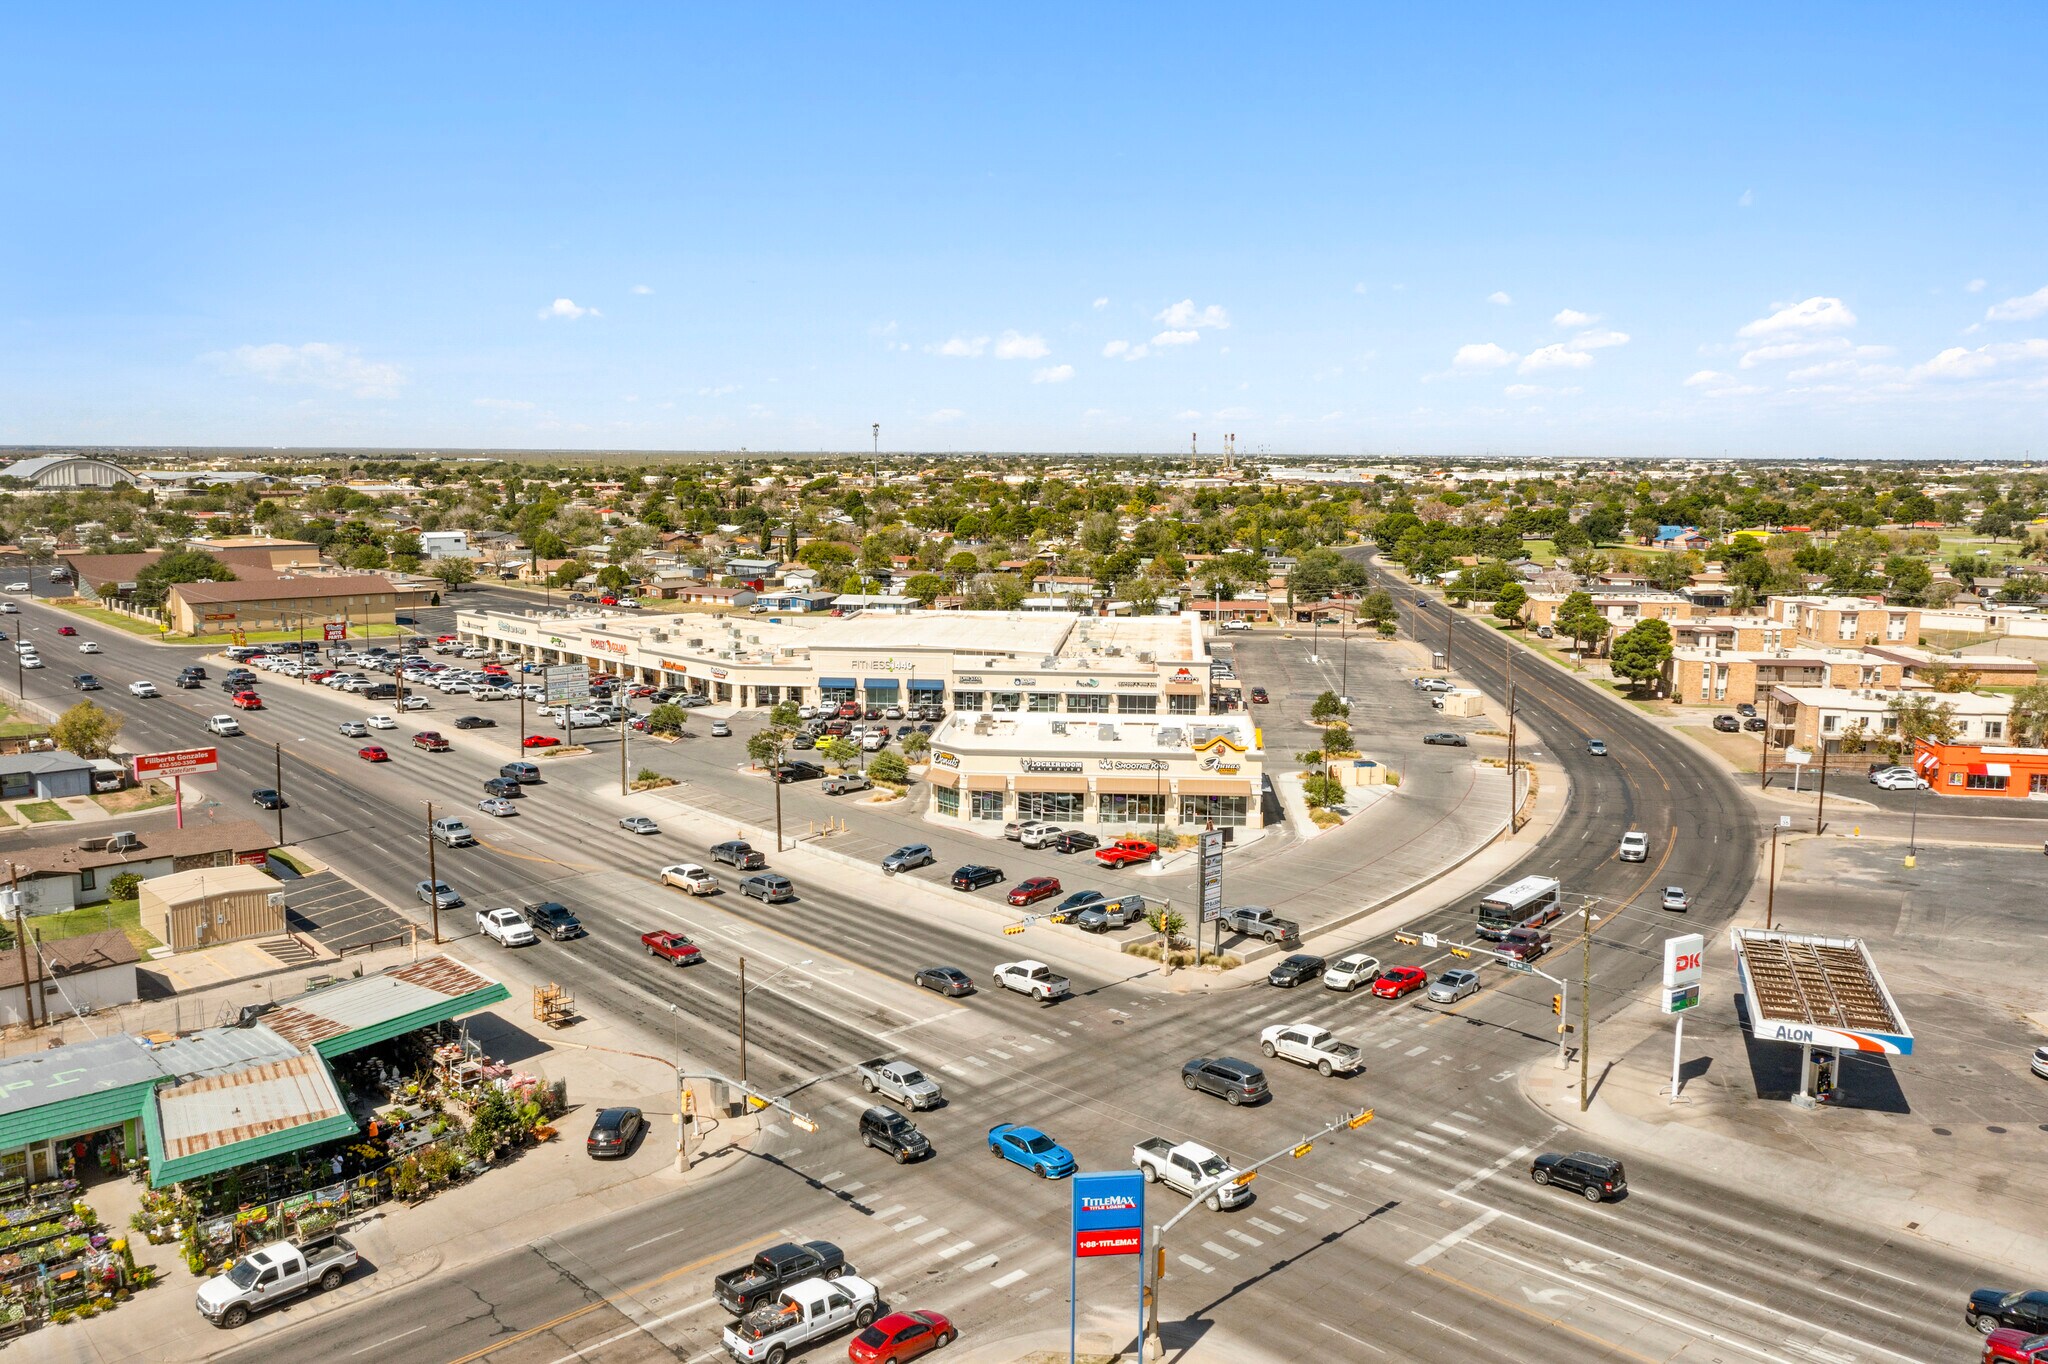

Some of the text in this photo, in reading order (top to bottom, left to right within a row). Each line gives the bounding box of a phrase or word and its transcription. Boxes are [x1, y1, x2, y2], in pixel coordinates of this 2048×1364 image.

[852, 660, 890, 669] FITNESS
[1676, 952, 1701, 972] DK
[1776, 1025, 1813, 1042] ALON
